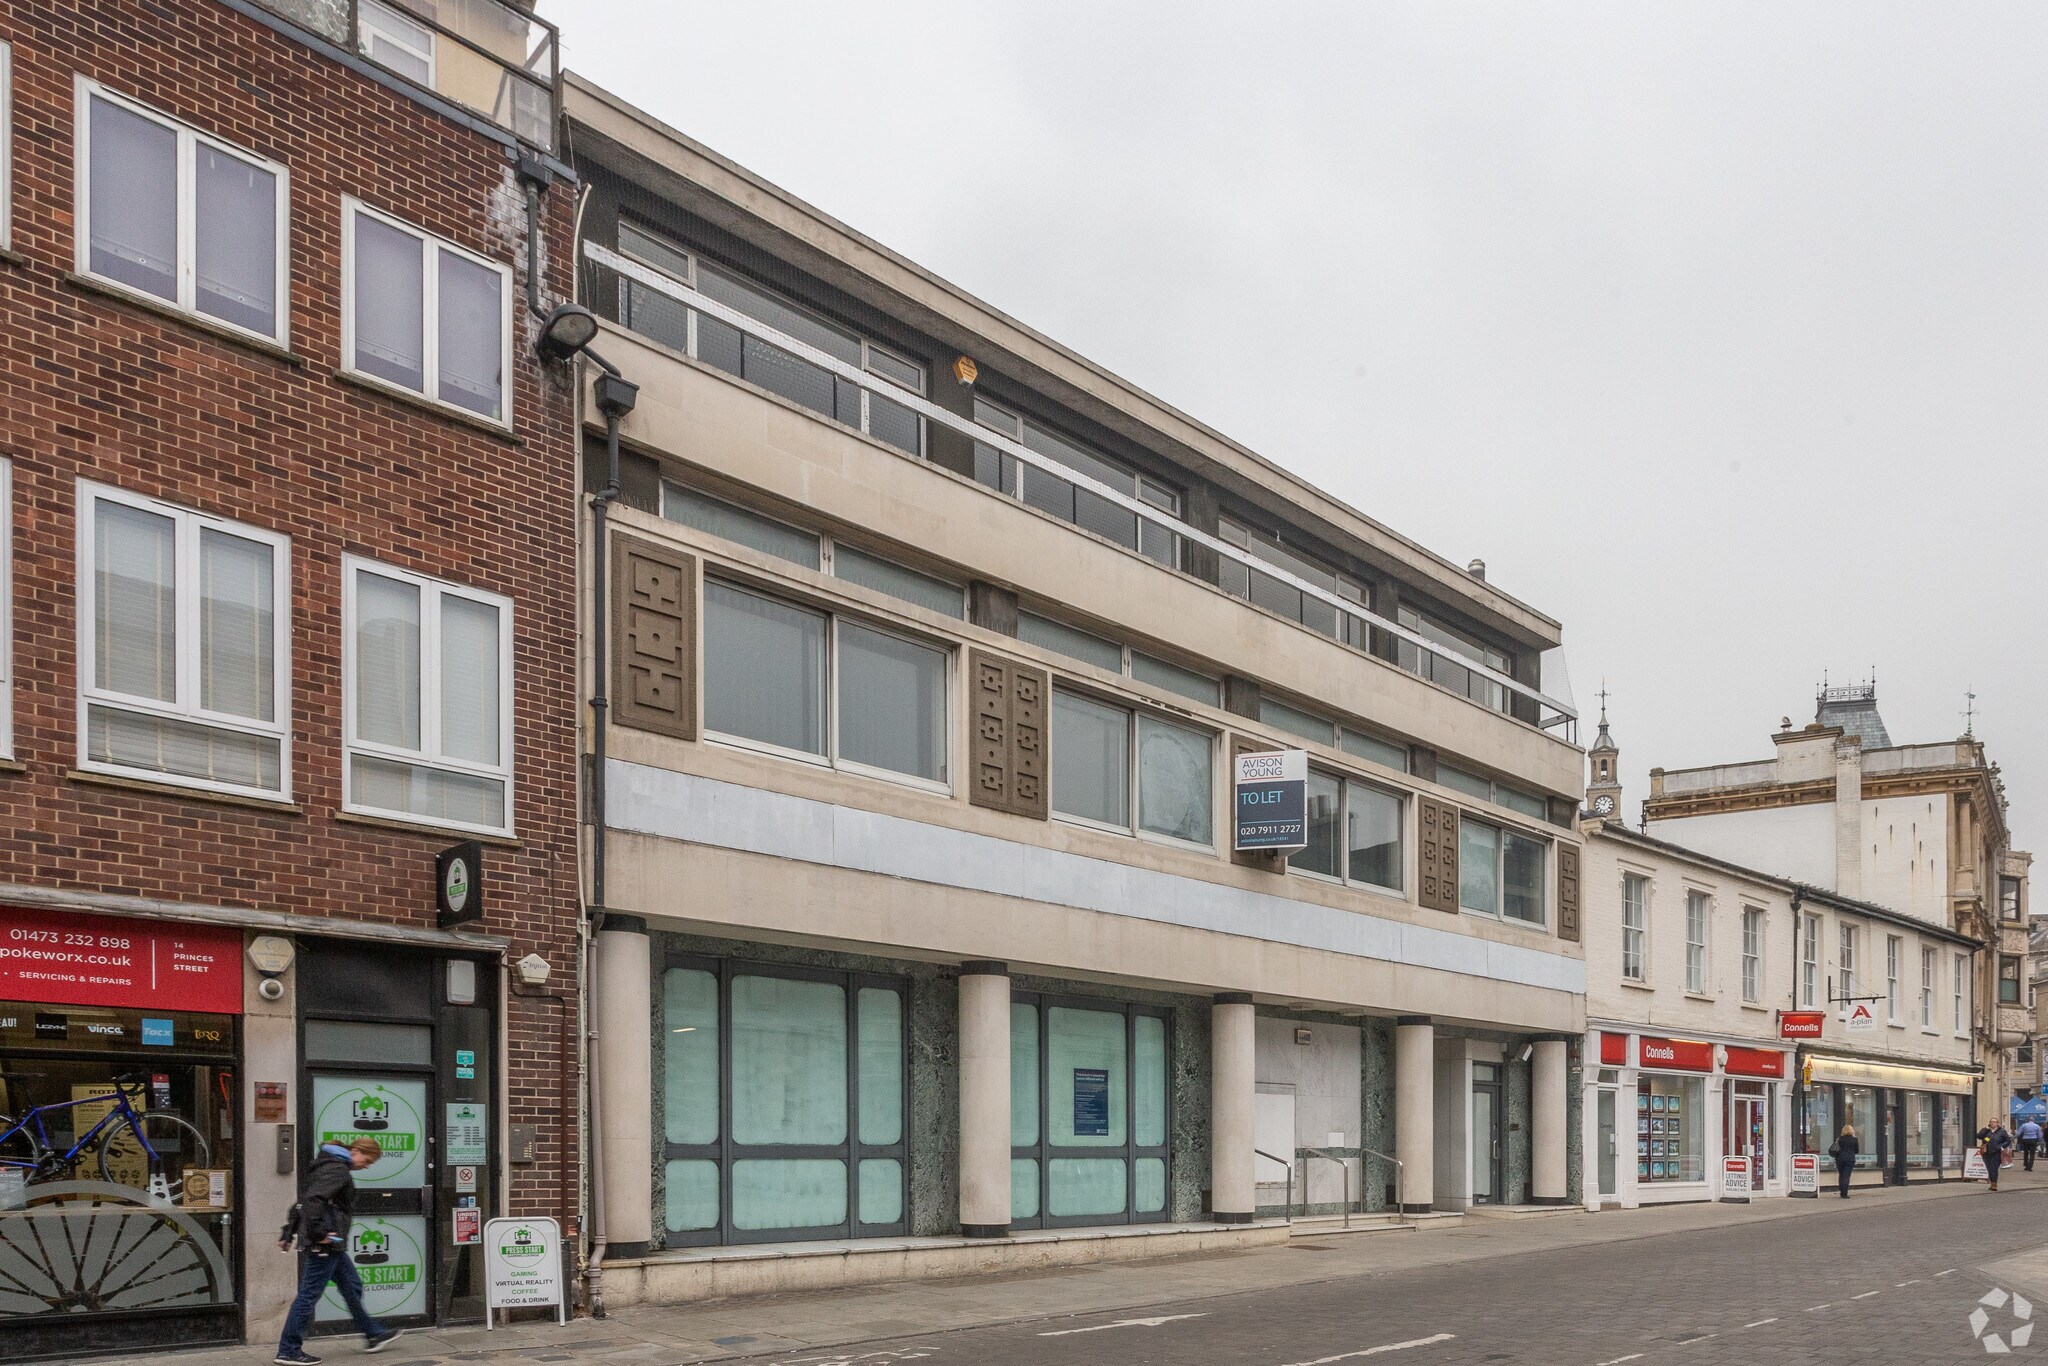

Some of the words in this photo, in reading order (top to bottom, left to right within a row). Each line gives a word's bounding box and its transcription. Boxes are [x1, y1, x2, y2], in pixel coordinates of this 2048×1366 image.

[1242, 758, 1282, 769] AVISON
[1242, 767, 1283, 778] YOUNG
[1241, 792, 1259, 805] TO
[1261, 790, 1284, 804] LET
[1241, 826, 1256, 836] 020
[1258, 825, 1277, 835] 7911
[1280, 824, 1301, 834] 2727
[10, 928, 58, 944] 01473
[64, 933, 94, 947] 232
[99, 936, 130, 949] 898
[0, 947, 131, 967] pokeworx.co.uk
[174, 953, 214, 963] PRINCES
[173, 964, 209, 973] STREET
[19, 971, 76, 982] SERVICING
[79, 975, 86, 983] &
[89, 975, 132, 986] REPAIRS
[1784, 1023, 1819, 1032] Connells
[1645, 1044, 1674, 1060] Connells
[374, 1134, 409, 1149] START
[1725, 1179, 1747, 1187] ADVICE
[505, 1246, 523, 1254] PRESS
[524, 1245, 542, 1254] START
[375, 1266, 409, 1283] START
[372, 1283, 405, 1292] LOUNGE
